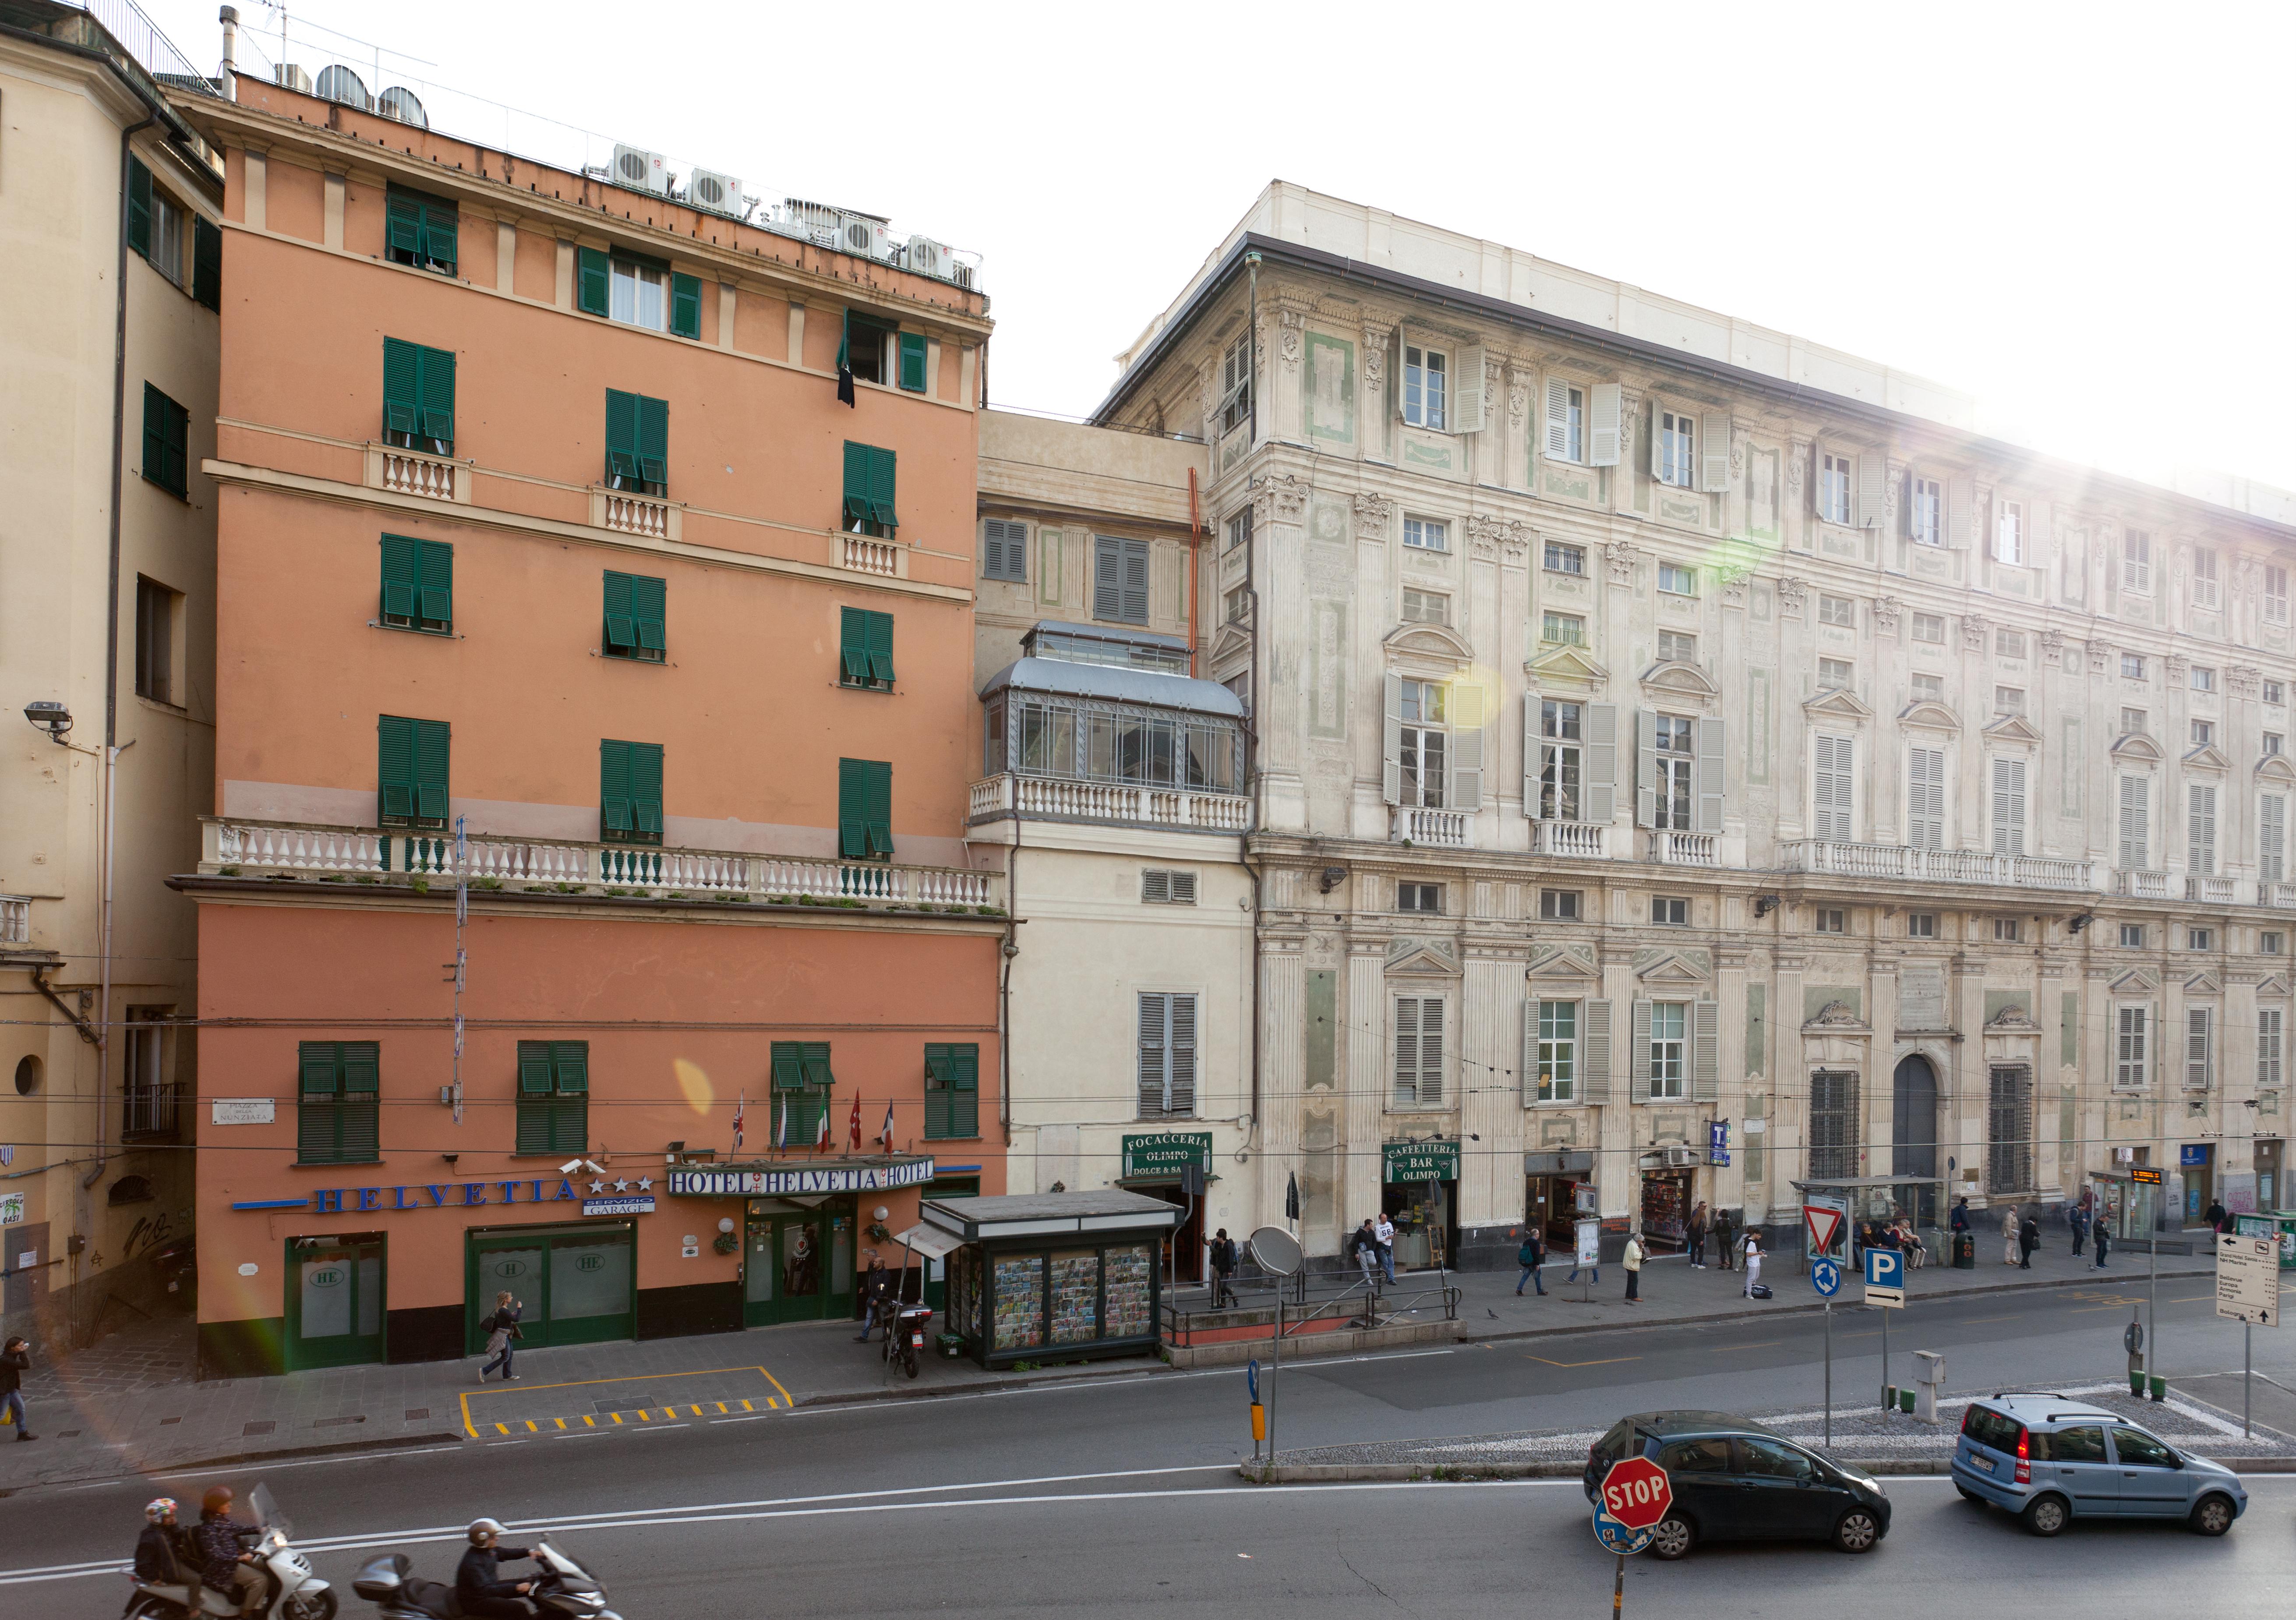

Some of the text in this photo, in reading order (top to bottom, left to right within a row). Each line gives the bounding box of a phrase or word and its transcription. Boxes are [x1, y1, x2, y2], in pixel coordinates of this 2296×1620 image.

[1714, 1126, 1724, 1144] T
[1127, 1134, 1208, 1151] FOCACCERIA
[1146, 1150, 1188, 1161] OLIMPO
[1388, 1144, 1456, 1159] CAFFETTERIA
[1410, 1157, 1433, 1168] BAR
[671, 1160, 933, 1193] HOTEL HELVETIA HOTEL
[1403, 1170, 1441, 1180] OLIMPO
[314, 1178, 578, 1213] HELVETIA
[590, 1205, 645, 1214] GARAGE
[4, 1214, 19, 1224] OASI
[581, 1256, 600, 1269] HE
[1873, 1252, 1896, 1282] P
[318, 1272, 337, 1284] HE
[2220, 1309, 2244, 1317] Bologna
[1607, 1475, 1664, 1510] STOP
